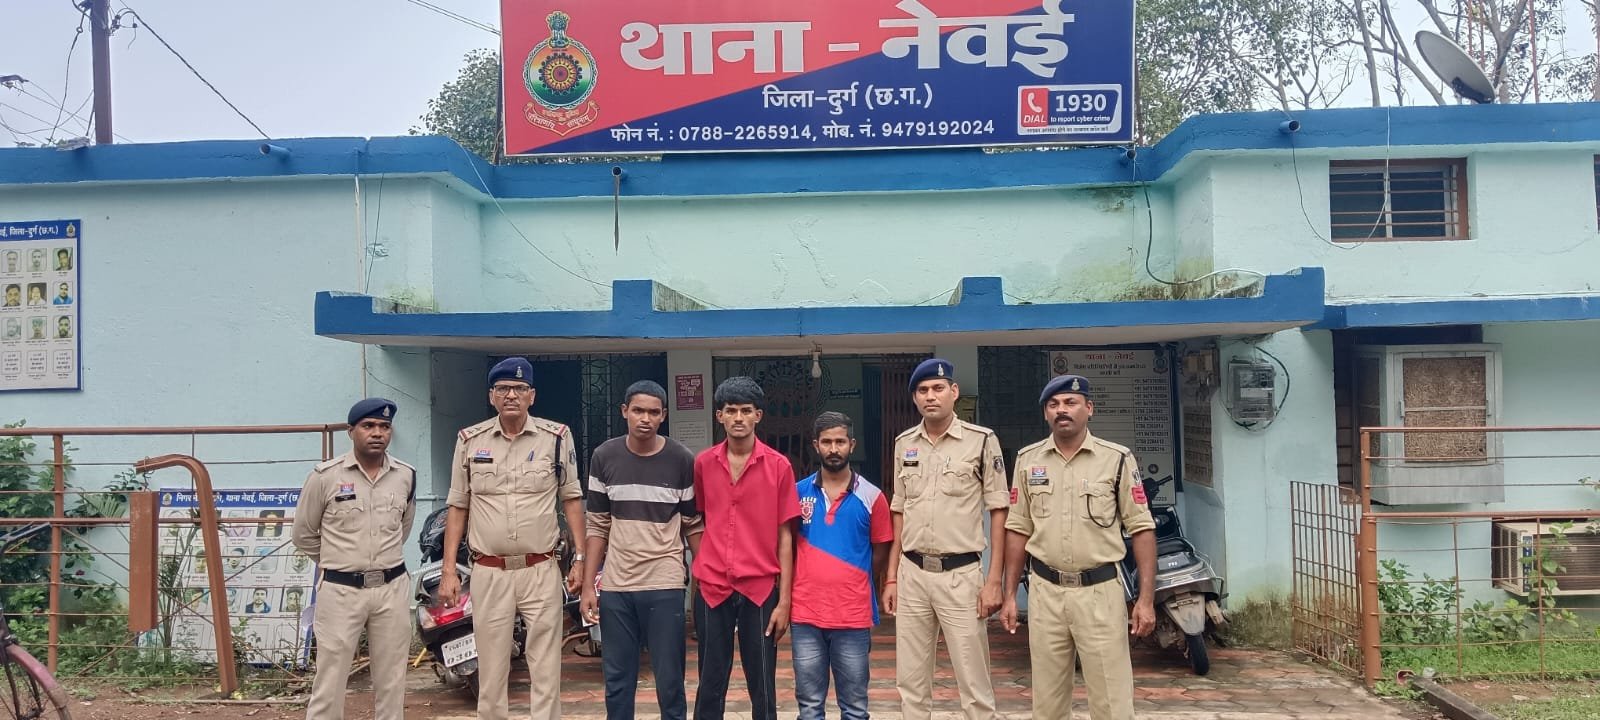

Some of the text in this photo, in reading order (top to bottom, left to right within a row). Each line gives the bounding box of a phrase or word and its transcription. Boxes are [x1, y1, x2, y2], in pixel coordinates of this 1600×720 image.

[620, 21, 811, 75] थाना
[879, 0, 1074, 78] नेवई
[762, 83, 933, 115] जिला-दुर्ग (छ.ग.)
[1055, 93, 1107, 112] 1930
[1023, 114, 1047, 124] DIAL
[1077, 116, 1093, 124] cyber
[610, 123, 643, 142] फोन
[647, 122, 664, 141] नं.
[679, 124, 817, 142] 0788-2265914,
[822, 120, 854, 138] मोब.
[859, 118, 876, 138] नं.
[882, 119, 995, 137] 9479192024
